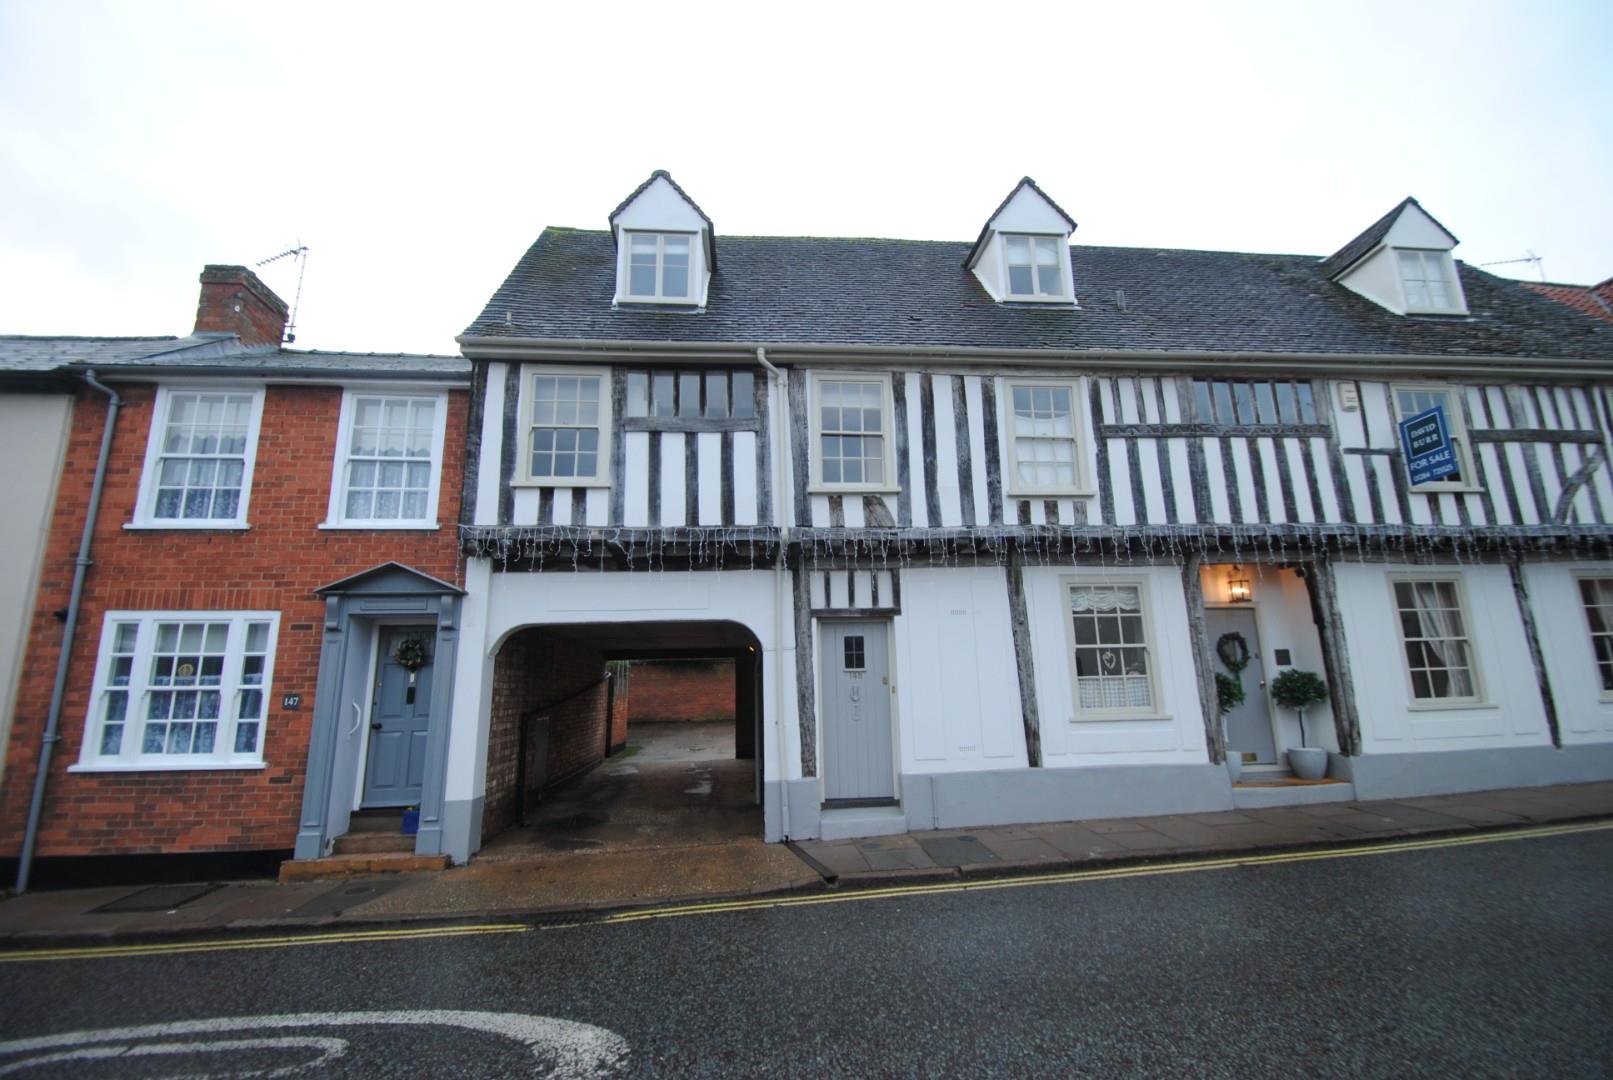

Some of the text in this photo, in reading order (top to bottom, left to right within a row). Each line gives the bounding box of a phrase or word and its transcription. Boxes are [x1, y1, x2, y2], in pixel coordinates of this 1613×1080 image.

[1410, 423, 1436, 438] DAVID
[1413, 434, 1439, 448] BURR
[1410, 450, 1451, 470] FOR SALE
[284, 697, 299, 706] 147
